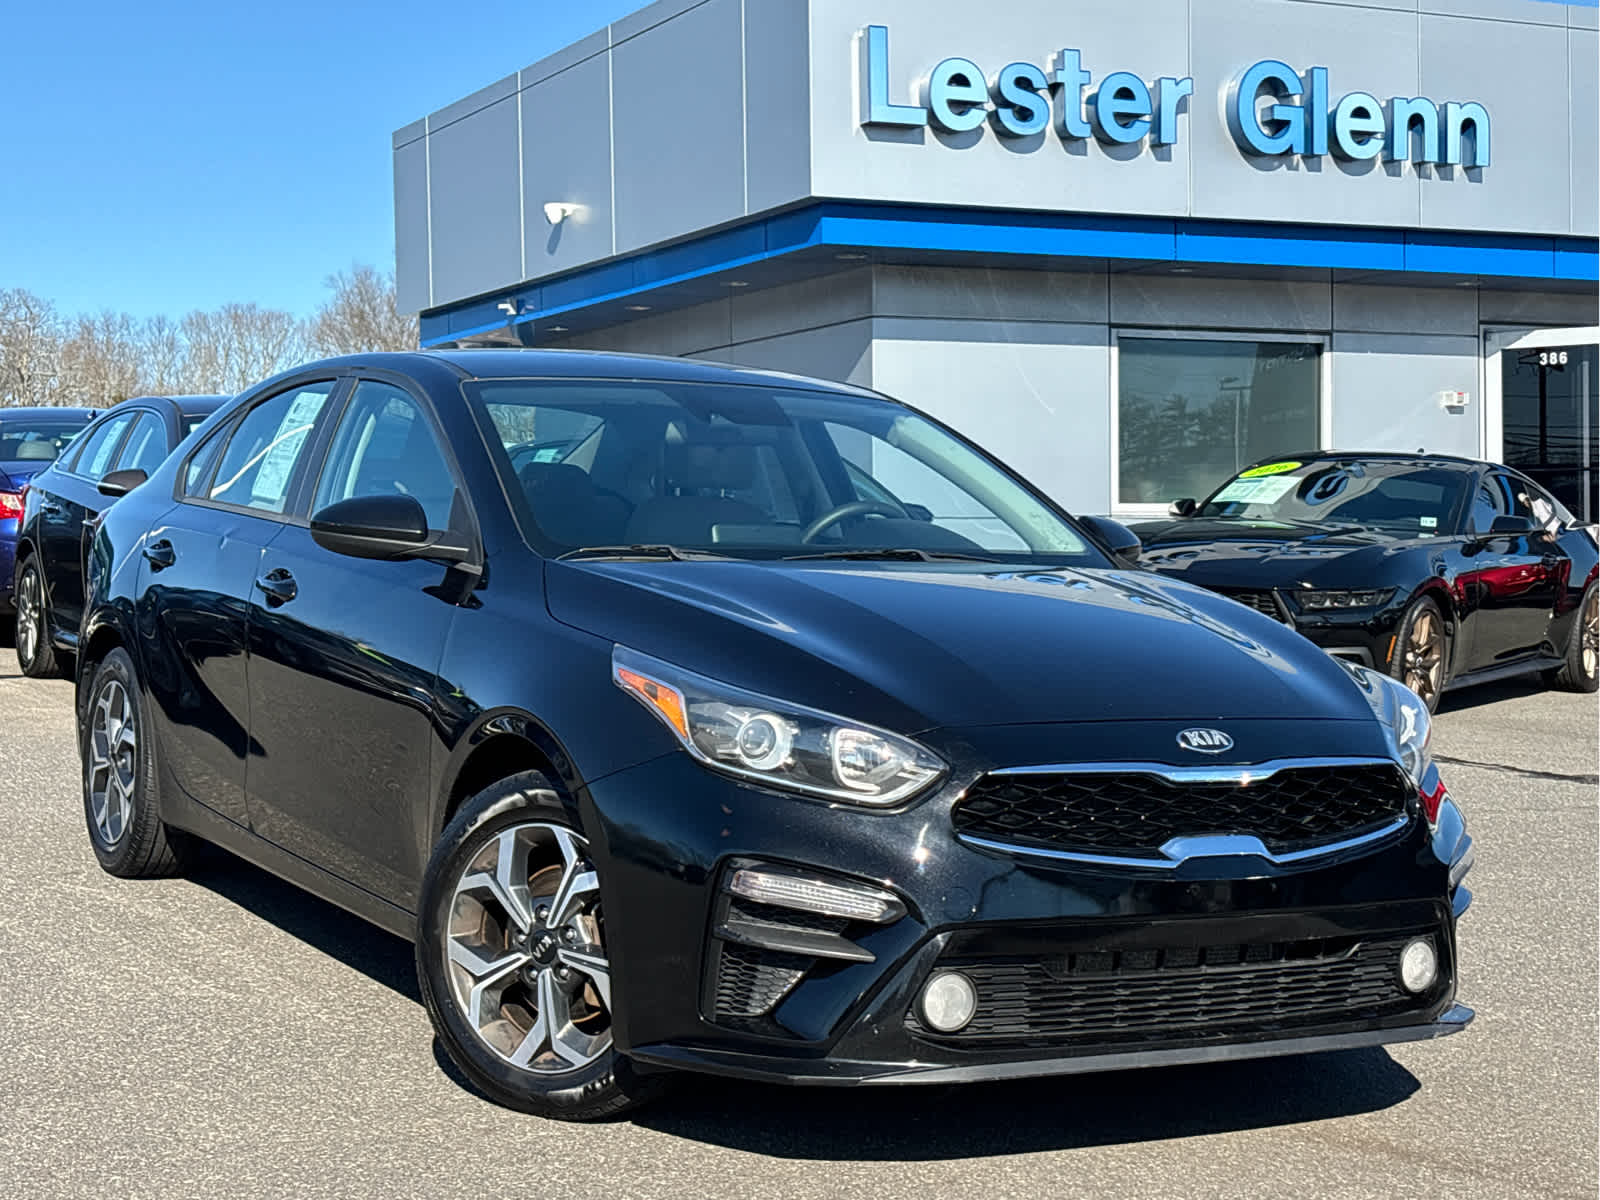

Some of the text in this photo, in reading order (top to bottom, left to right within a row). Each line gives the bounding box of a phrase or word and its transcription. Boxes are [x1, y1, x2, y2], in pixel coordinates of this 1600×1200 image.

[861, 24, 1491, 167] Lester Glenn
[1539, 351, 1568, 366] 386
[1184, 730, 1229, 746] KIA
[532, 935, 552, 959] KIA
